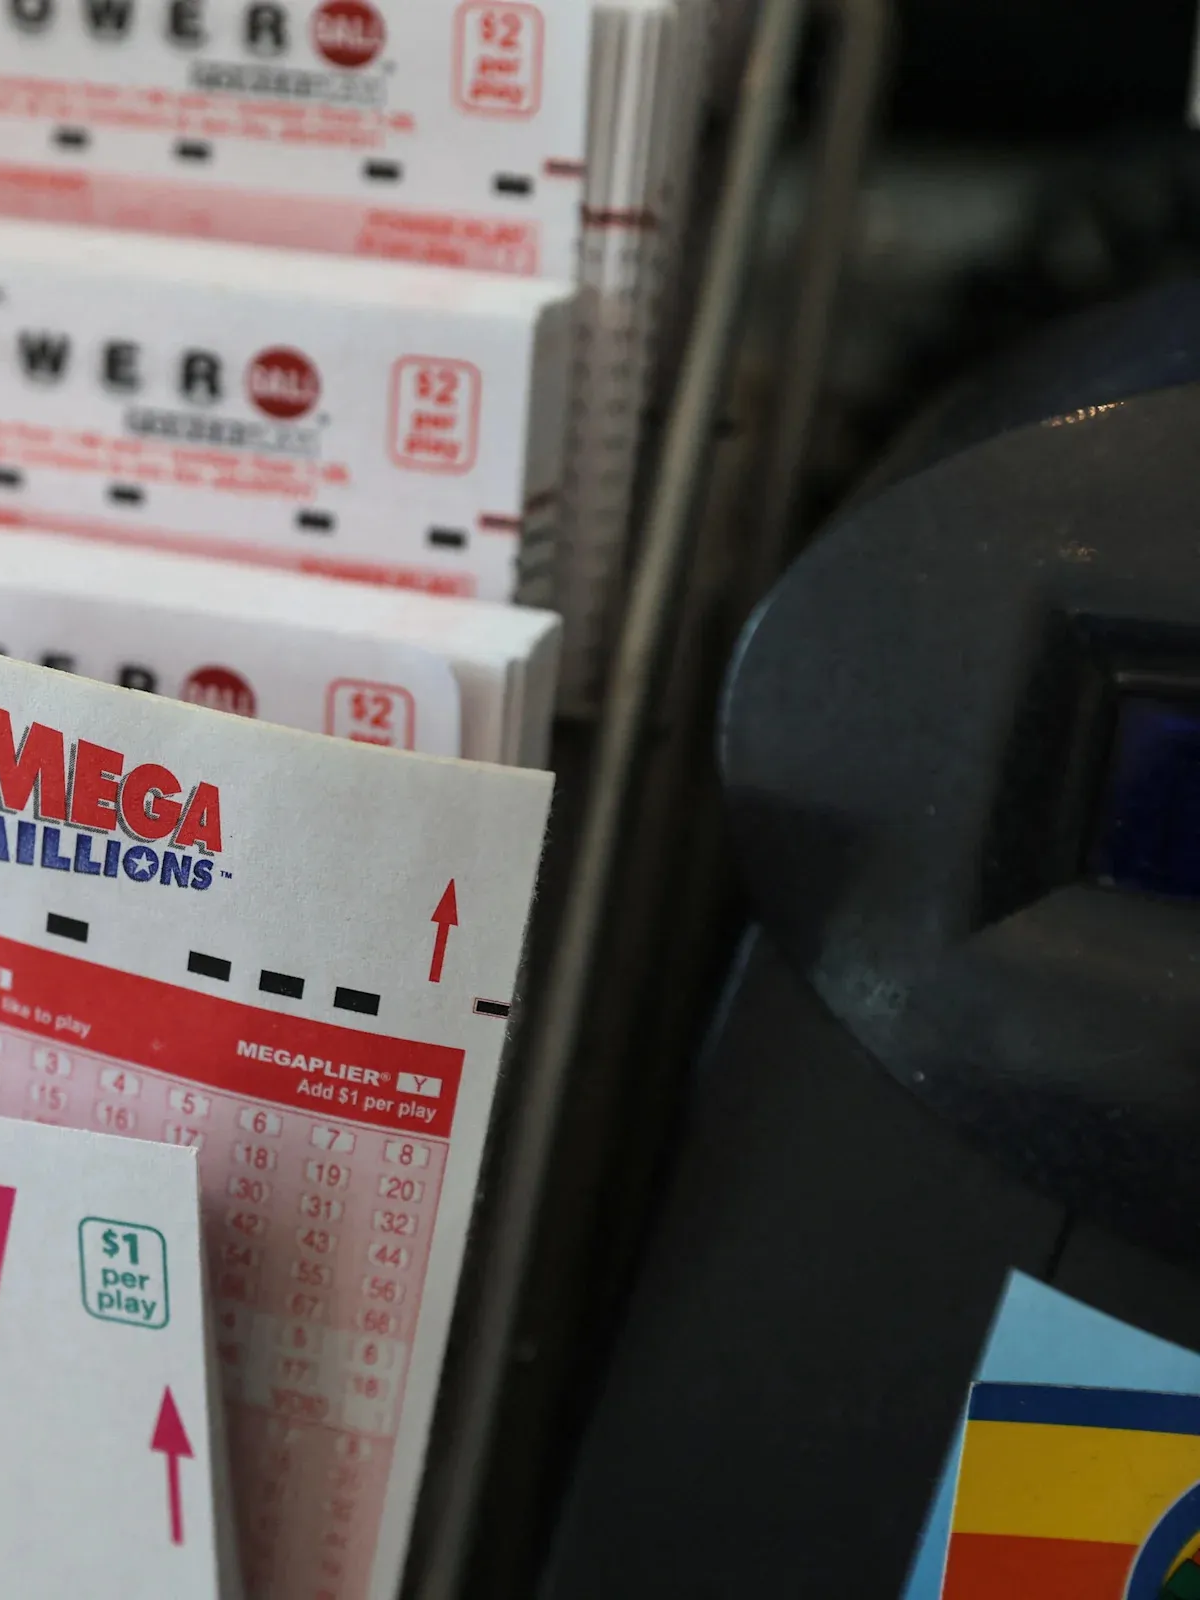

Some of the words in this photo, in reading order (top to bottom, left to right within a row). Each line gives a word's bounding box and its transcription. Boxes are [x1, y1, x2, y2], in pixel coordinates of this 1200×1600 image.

[481, 11, 521, 48] $2
[416, 368, 459, 406] $2
[352, 692, 393, 730] $2
[1, 994, 31, 1019] like
[34, 1005, 52, 1025] to
[55, 1014, 91, 1039] play
[297, 1078, 334, 1101] Add
[338, 1089, 358, 1106] $1
[364, 1094, 394, 1112] per
[398, 1100, 437, 1124] play
[413, 1075, 427, 1092] Y
[45, 1052, 59, 1075] 3
[113, 1072, 126, 1094] 4
[181, 1092, 195, 1115] 5
[253, 1111, 267, 1134] 6
[326, 1128, 341, 1150] 7
[400, 1144, 414, 1166] 8
[39, 1081, 61, 1110] 15
[104, 1105, 128, 1131] 16
[174, 1123, 198, 1147] 17
[243, 1145, 268, 1170] 18
[315, 1162, 341, 1187] 19
[386, 1177, 414, 1202] 20
[236, 1176, 263, 1203] 30
[307, 1195, 332, 1220] 31
[380, 1211, 408, 1235] 32
[101, 1228, 140, 1265] $1
[232, 1211, 258, 1237] 42
[302, 1229, 330, 1254] 43
[375, 1244, 401, 1267] 44
[101, 1267, 150, 1291] per
[298, 1260, 323, 1286] 55
[369, 1275, 395, 1302] 56
[97, 1289, 157, 1320] play
[291, 1293, 318, 1318] 67
